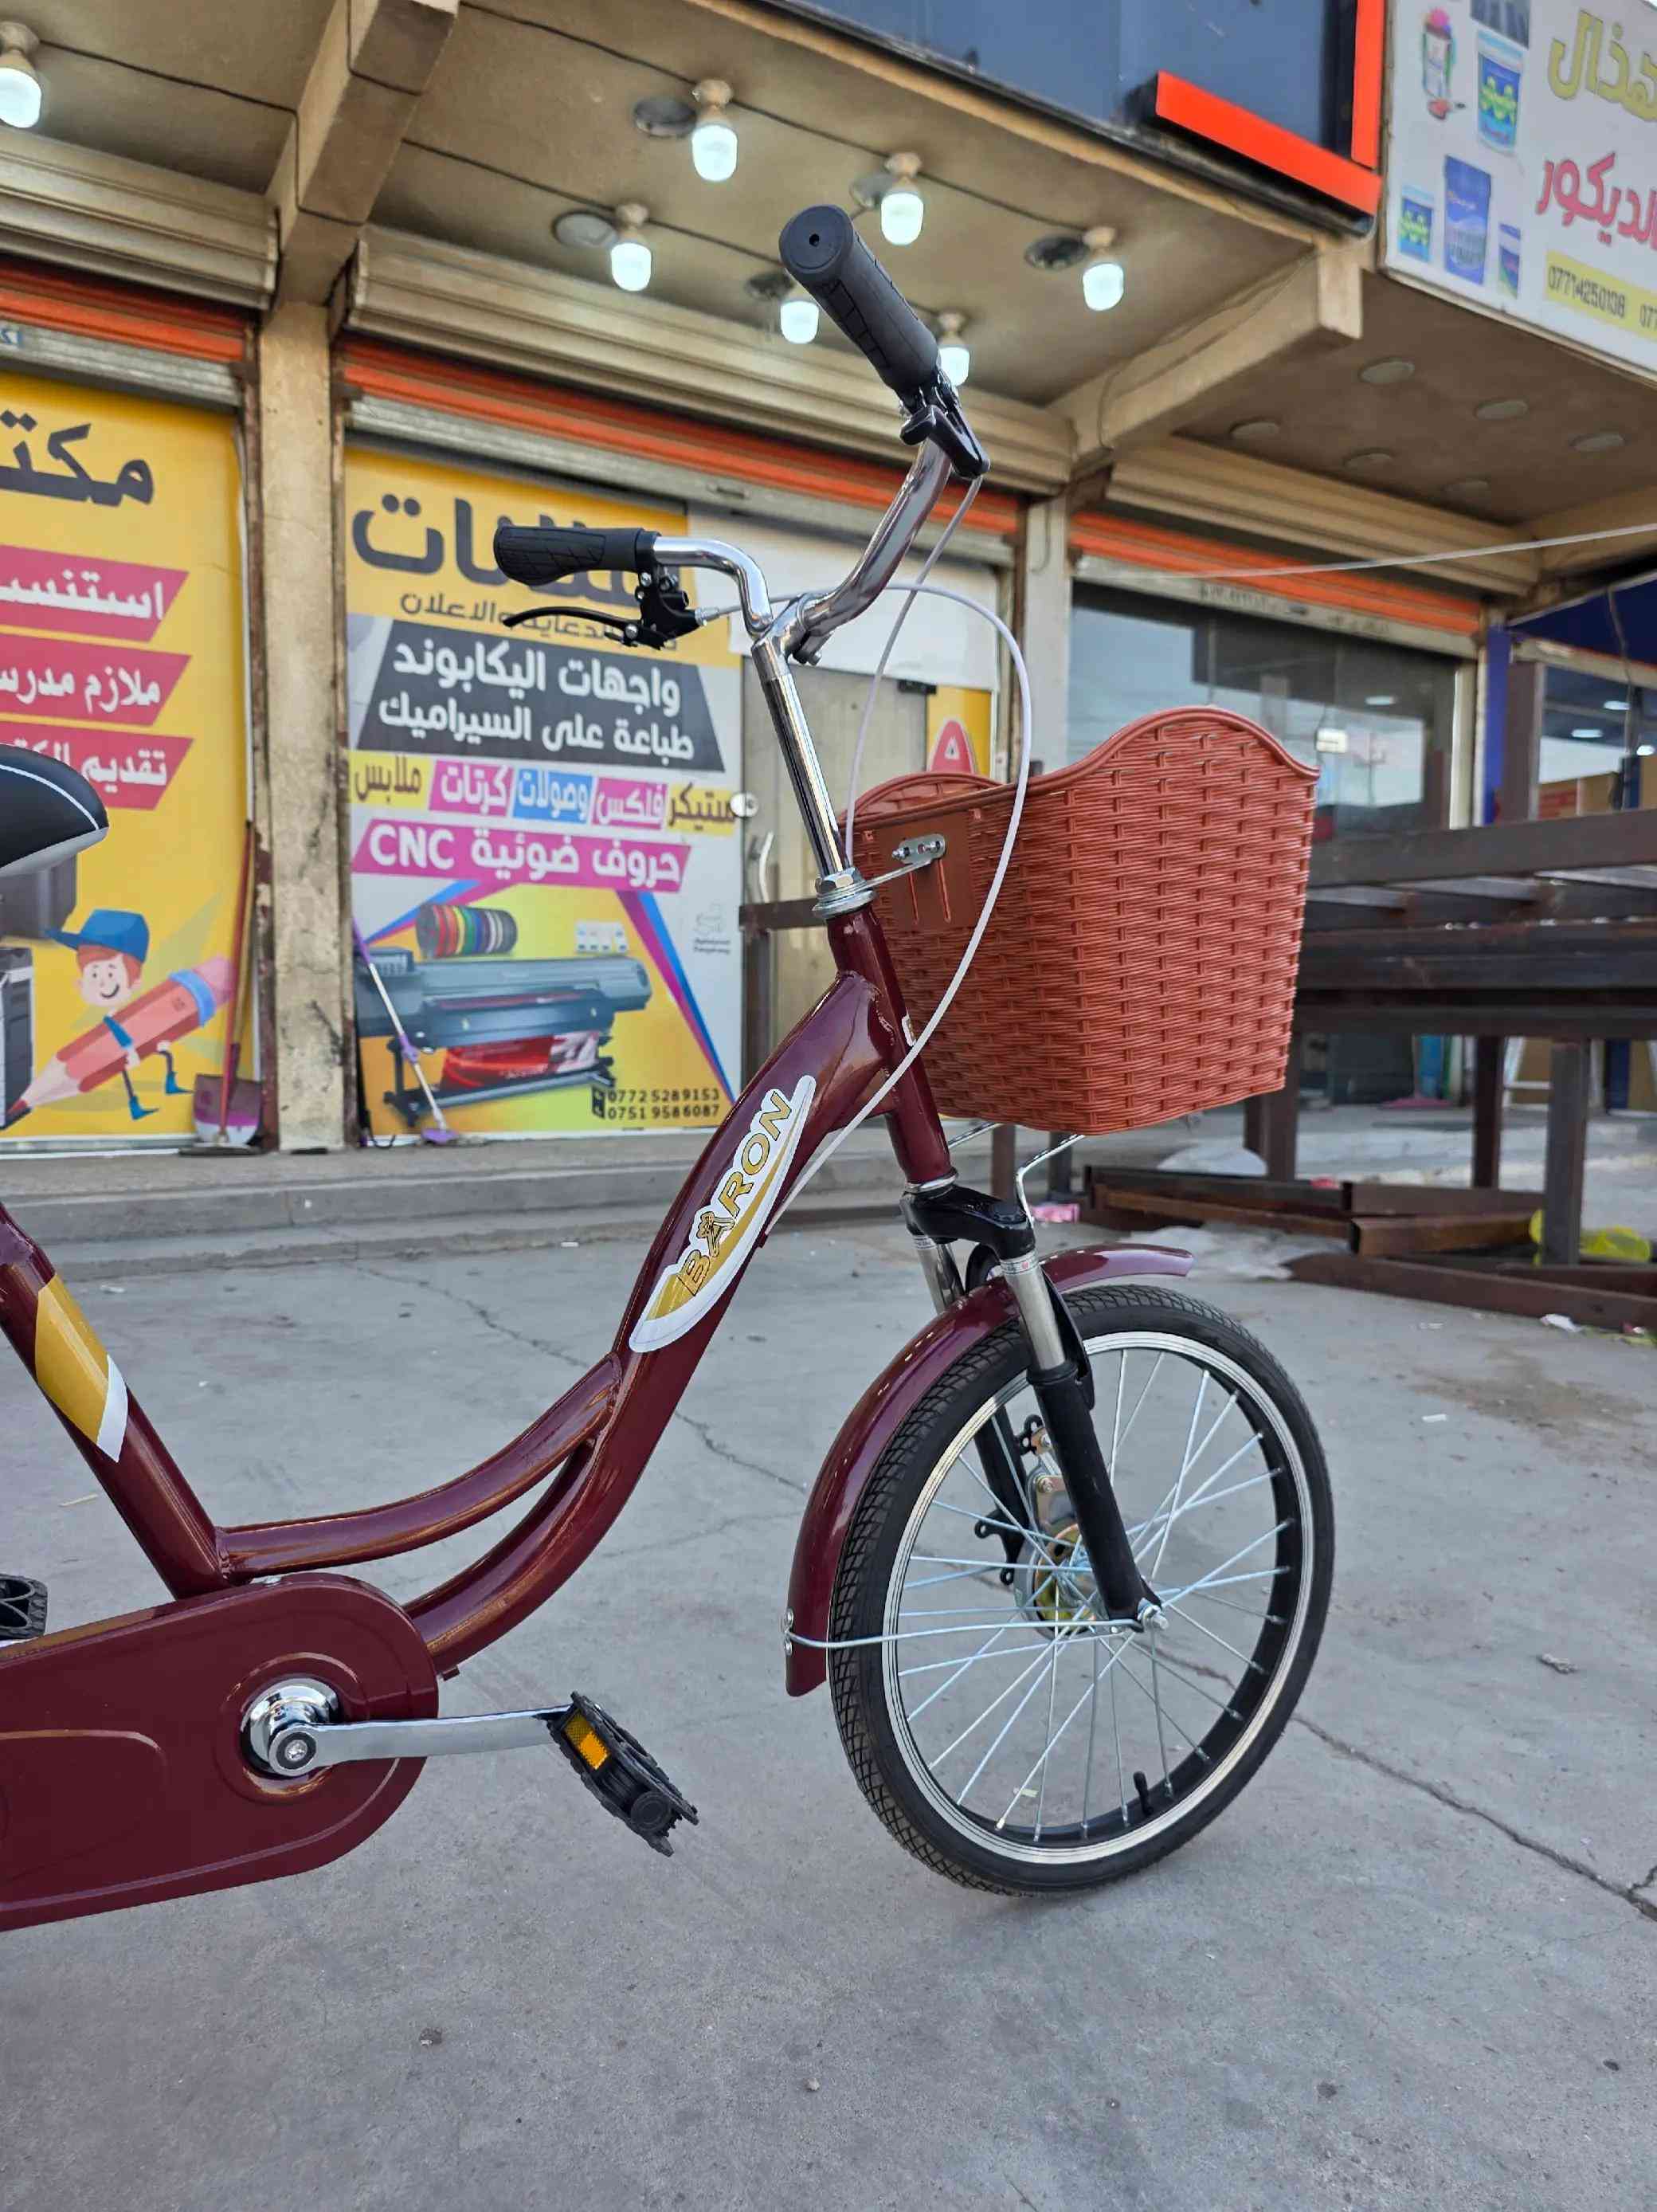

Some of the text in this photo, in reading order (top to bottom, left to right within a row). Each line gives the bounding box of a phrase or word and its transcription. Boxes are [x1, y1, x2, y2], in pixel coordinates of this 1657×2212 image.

[0, 410, 154, 508] مكت
[0, 568, 164, 620] استنس
[84, 665, 161, 713] ملازم
[393, 638, 680, 717] واجهات اليكابوند
[378, 691, 695, 766] طباعة على السيراميك
[355, 755, 422, 803] ملابس
[369, 823, 680, 888] حروف ضوئية CNC
[607, 1088, 647, 1103] 0772
[607, 1106, 646, 1120] 0751
[677, 1090, 791, 1296] BARON
